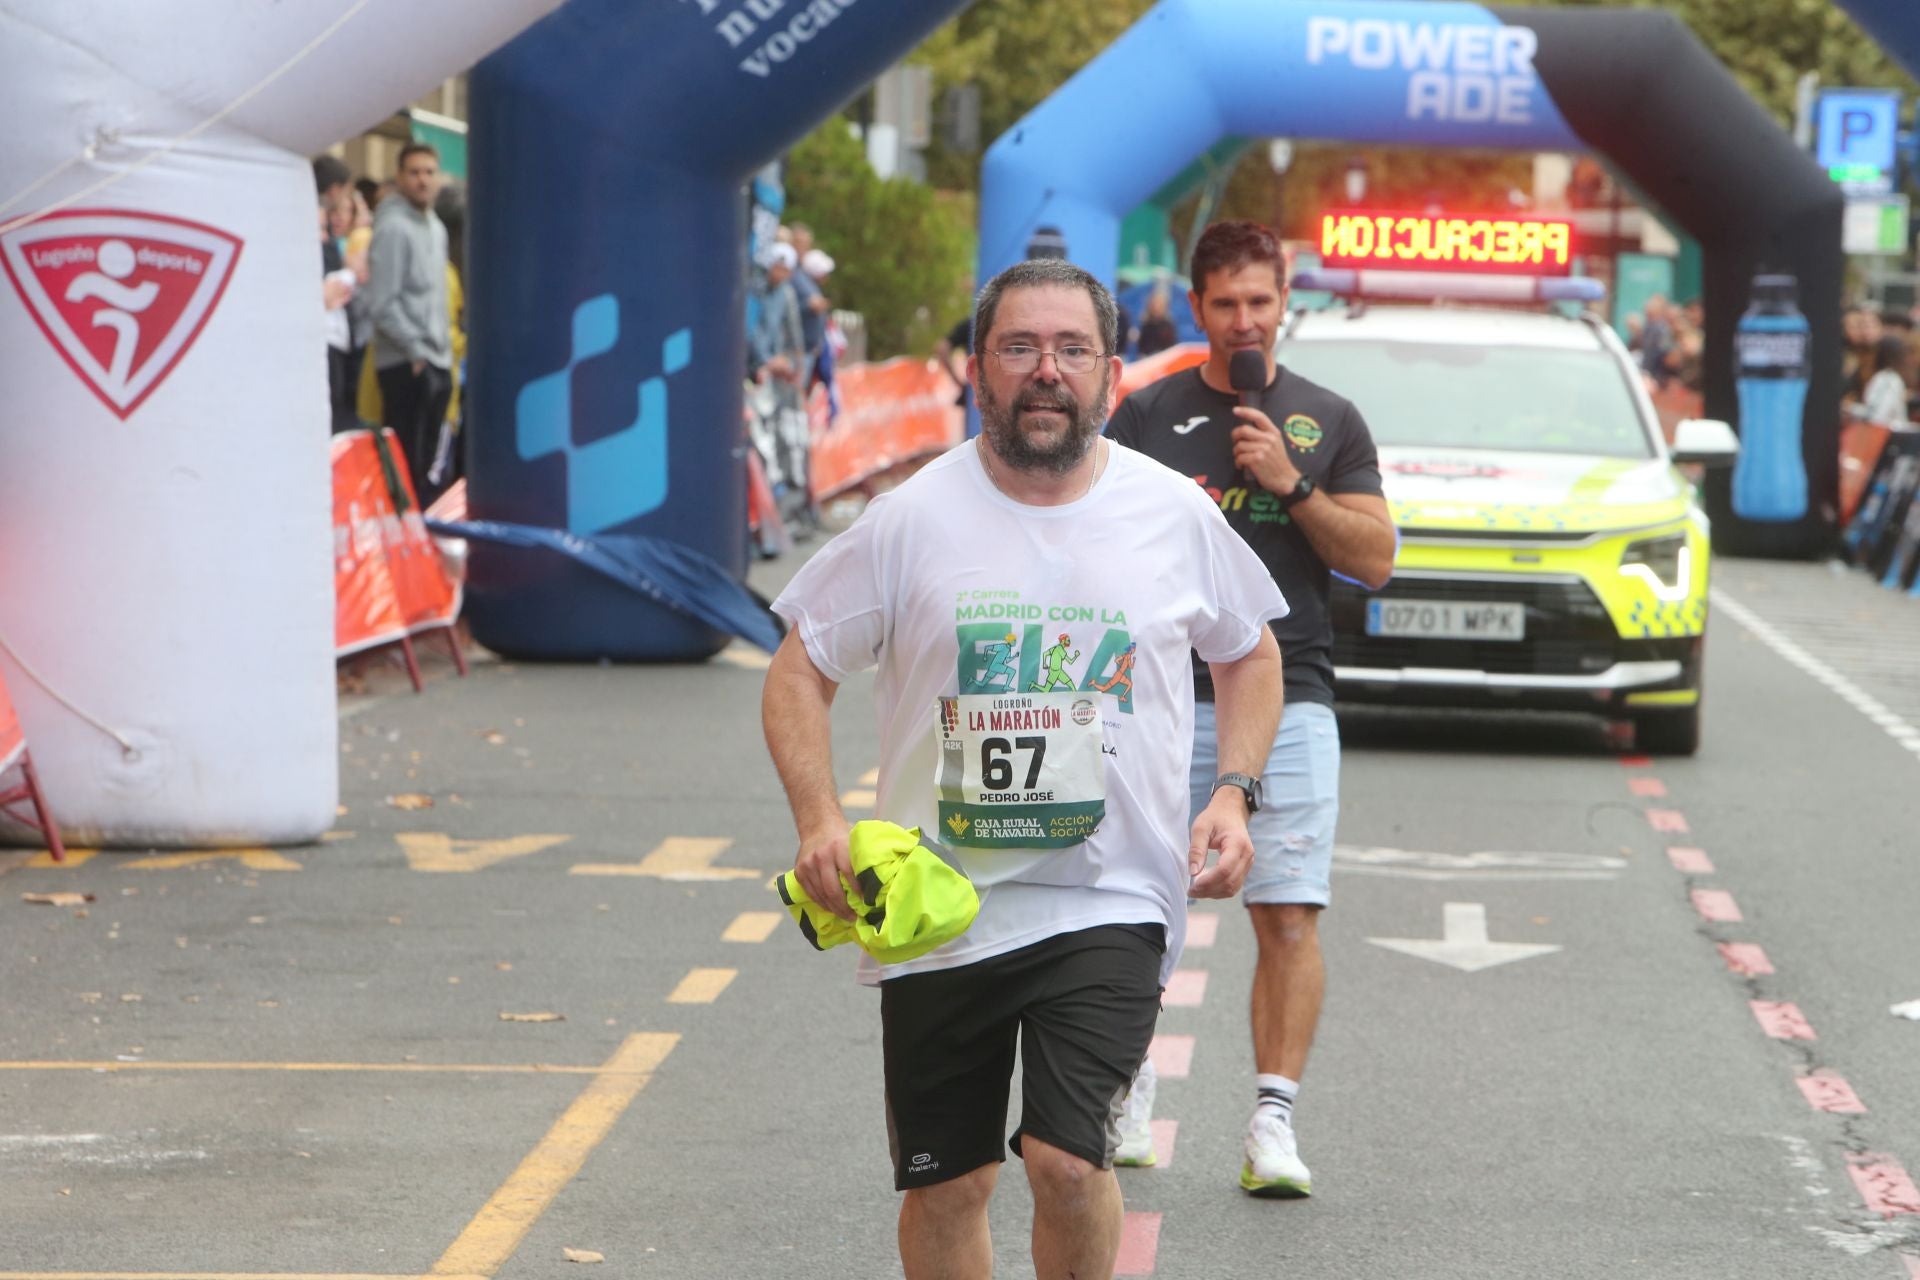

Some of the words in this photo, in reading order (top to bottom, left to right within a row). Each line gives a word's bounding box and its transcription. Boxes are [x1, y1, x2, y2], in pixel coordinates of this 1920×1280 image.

[1307, 16, 1537, 73] POWER
[1407, 71, 1536, 123] ADE
[1839, 110, 1873, 152] P
[32, 244, 95, 268] Logroño
[137, 247, 203, 275] deporte
[972, 590, 1020, 600] Carrera
[956, 603, 1042, 621] MADRID
[1047, 607, 1095, 622] CON
[1100, 608, 1128, 626] LA
[1384, 606, 1450, 631] 0701
[993, 698, 1032, 710] LOGROÑO
[969, 711, 985, 732] LA
[990, 706, 1061, 731] MARATÓN
[944, 741, 962, 750] 42K
[981, 736, 1047, 790] 67
[980, 792, 1020, 803] PEDRO
[1023, 790, 1054, 802] JOSÉ
[974, 819, 1001, 829] CAJA
[1002, 818, 1041, 828] RURAL
[1050, 814, 1093, 827] ACCIÓN
[974, 828, 990, 838] DE
[992, 827, 1046, 838] NAVARRA
[1050, 827, 1092, 838] SOCIAL
